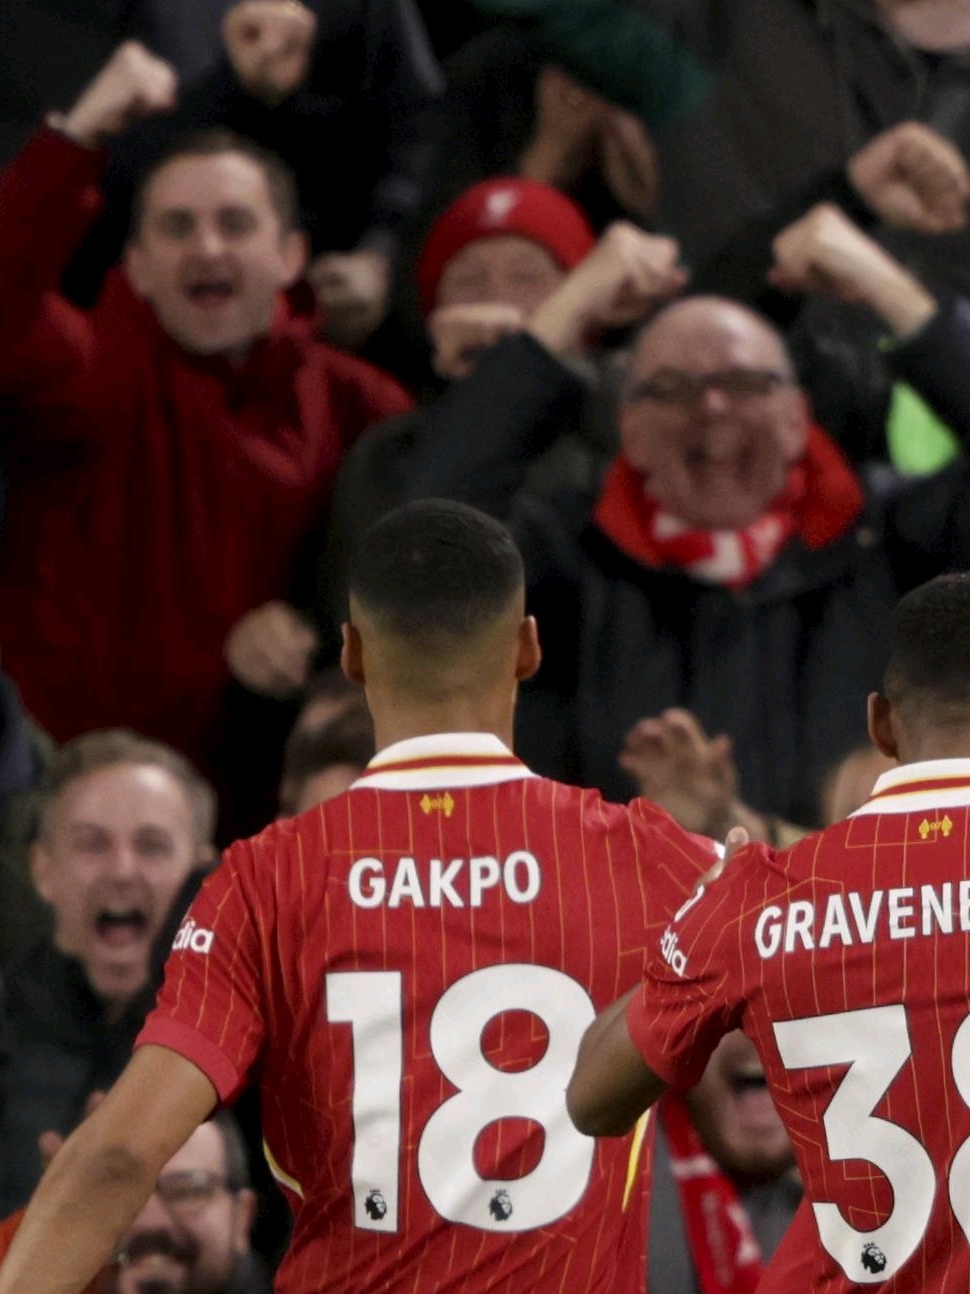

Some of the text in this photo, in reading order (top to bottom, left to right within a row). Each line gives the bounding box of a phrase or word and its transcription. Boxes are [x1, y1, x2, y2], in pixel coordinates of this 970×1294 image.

[347, 850, 541, 909] GAKPO
[171, 919, 214, 954] dia
[660, 923, 688, 977] dia
[325, 962, 598, 1234] 18
